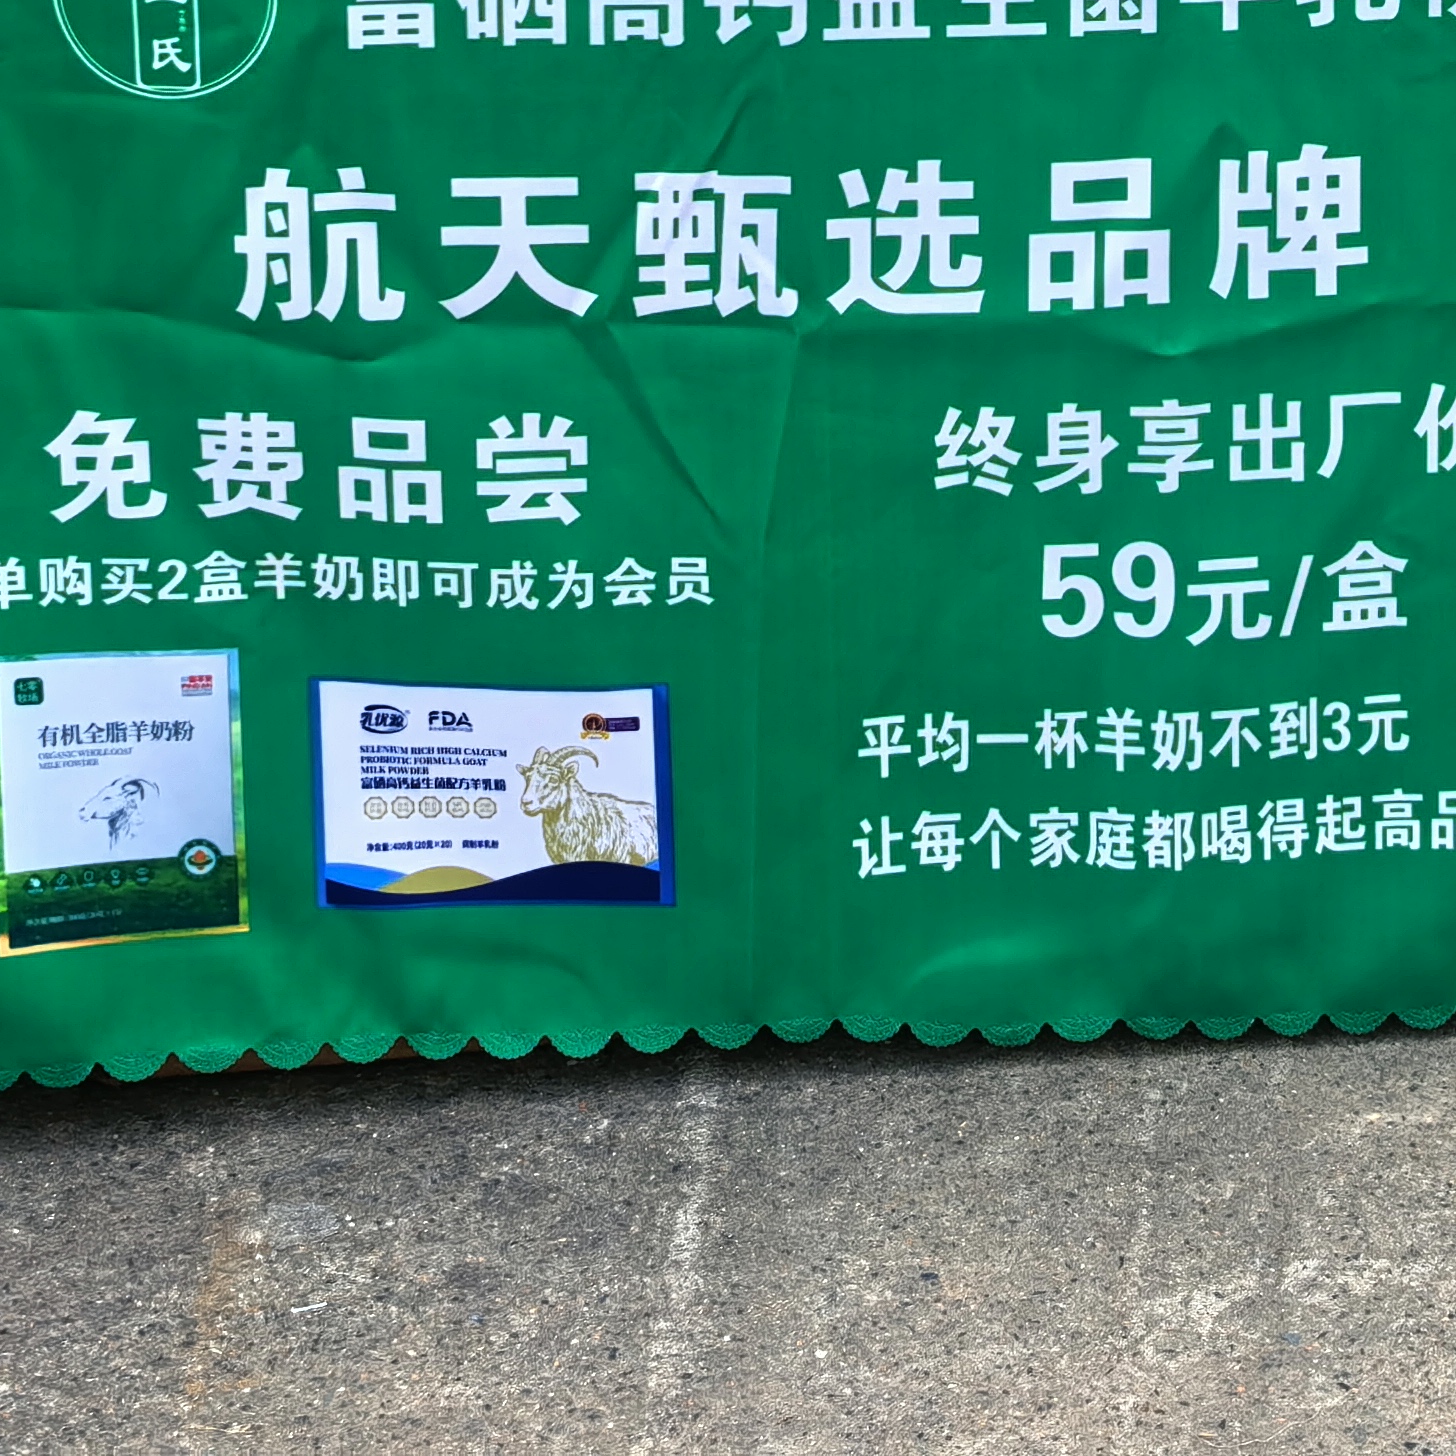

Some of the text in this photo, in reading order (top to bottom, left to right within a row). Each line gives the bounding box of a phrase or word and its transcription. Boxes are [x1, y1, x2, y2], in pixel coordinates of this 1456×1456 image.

[234, 143, 1370, 321] 航天甄选品牌
[44, 409, 590, 526] 免费品尝
[1040, 539, 1409, 645] 59元/盒
[38, 719, 195, 748] 有机全脂羊奶粉
[428, 710, 472, 727] FDA
[857, 692, 1411, 778] 平均一杯羊奶不到3元
